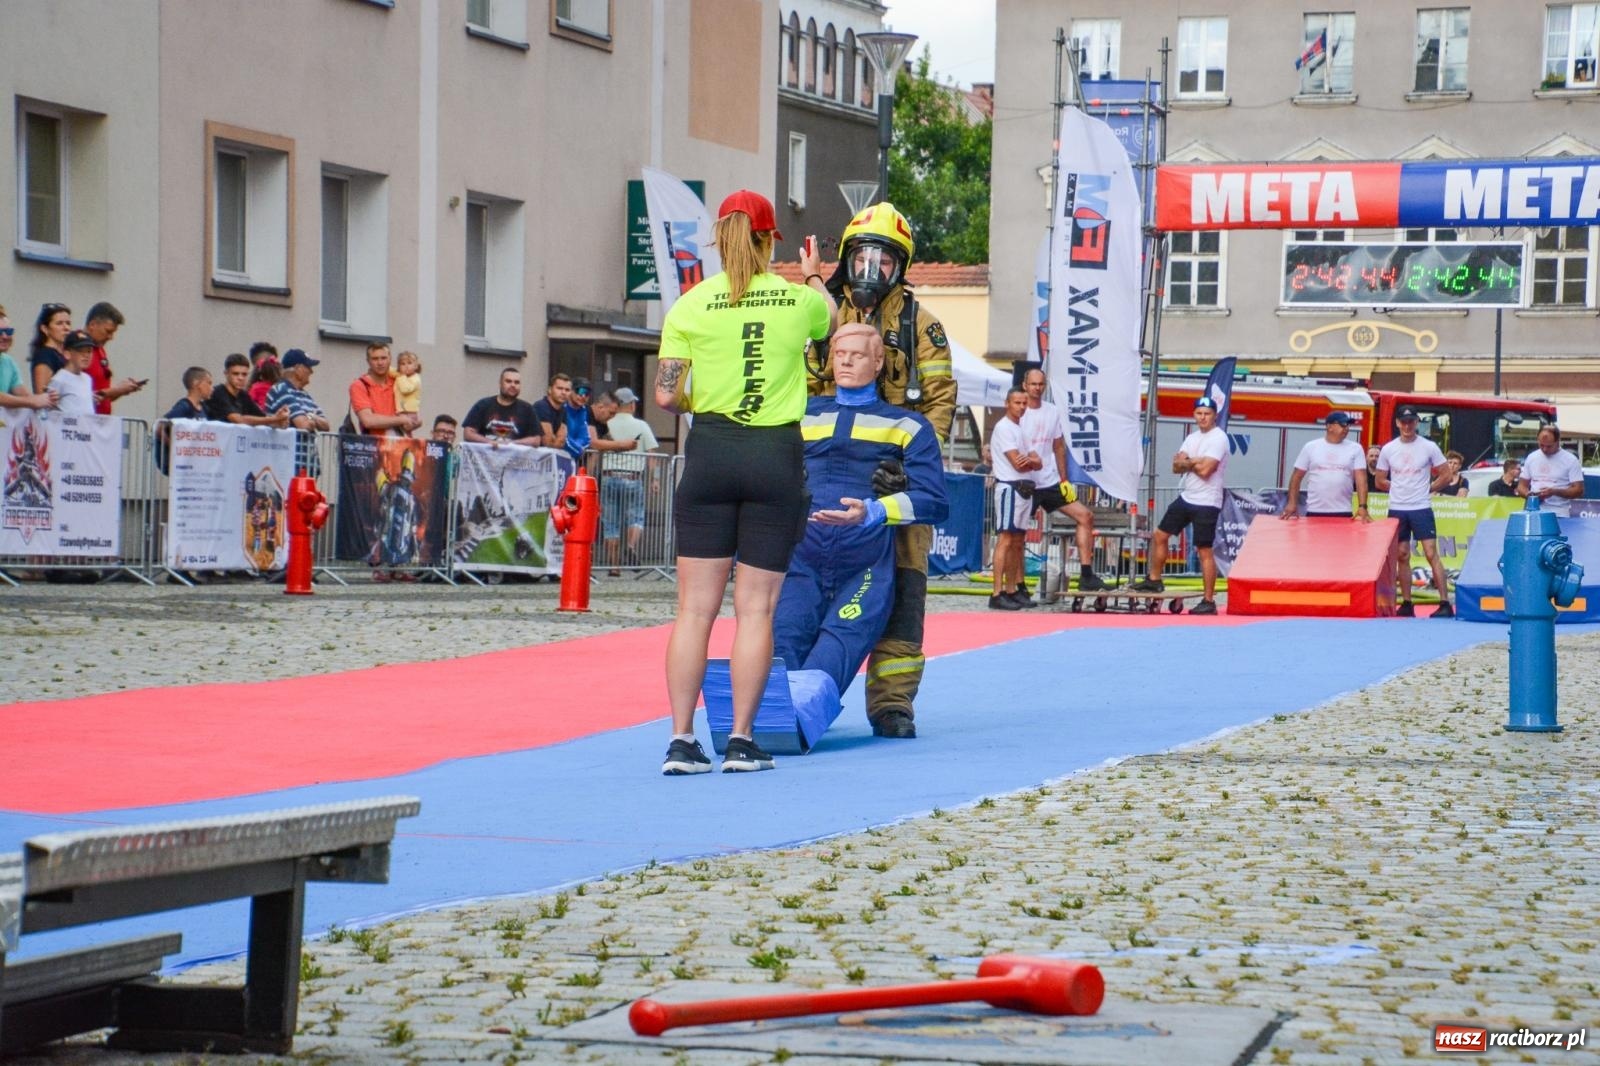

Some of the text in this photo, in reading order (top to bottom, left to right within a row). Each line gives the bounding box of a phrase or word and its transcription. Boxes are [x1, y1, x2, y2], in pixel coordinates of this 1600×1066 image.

[1190, 170, 1360, 225] META
[1292, 264, 1515, 290] 2:42.44 2:42.44
[713, 289, 788, 301] TOGHEST
